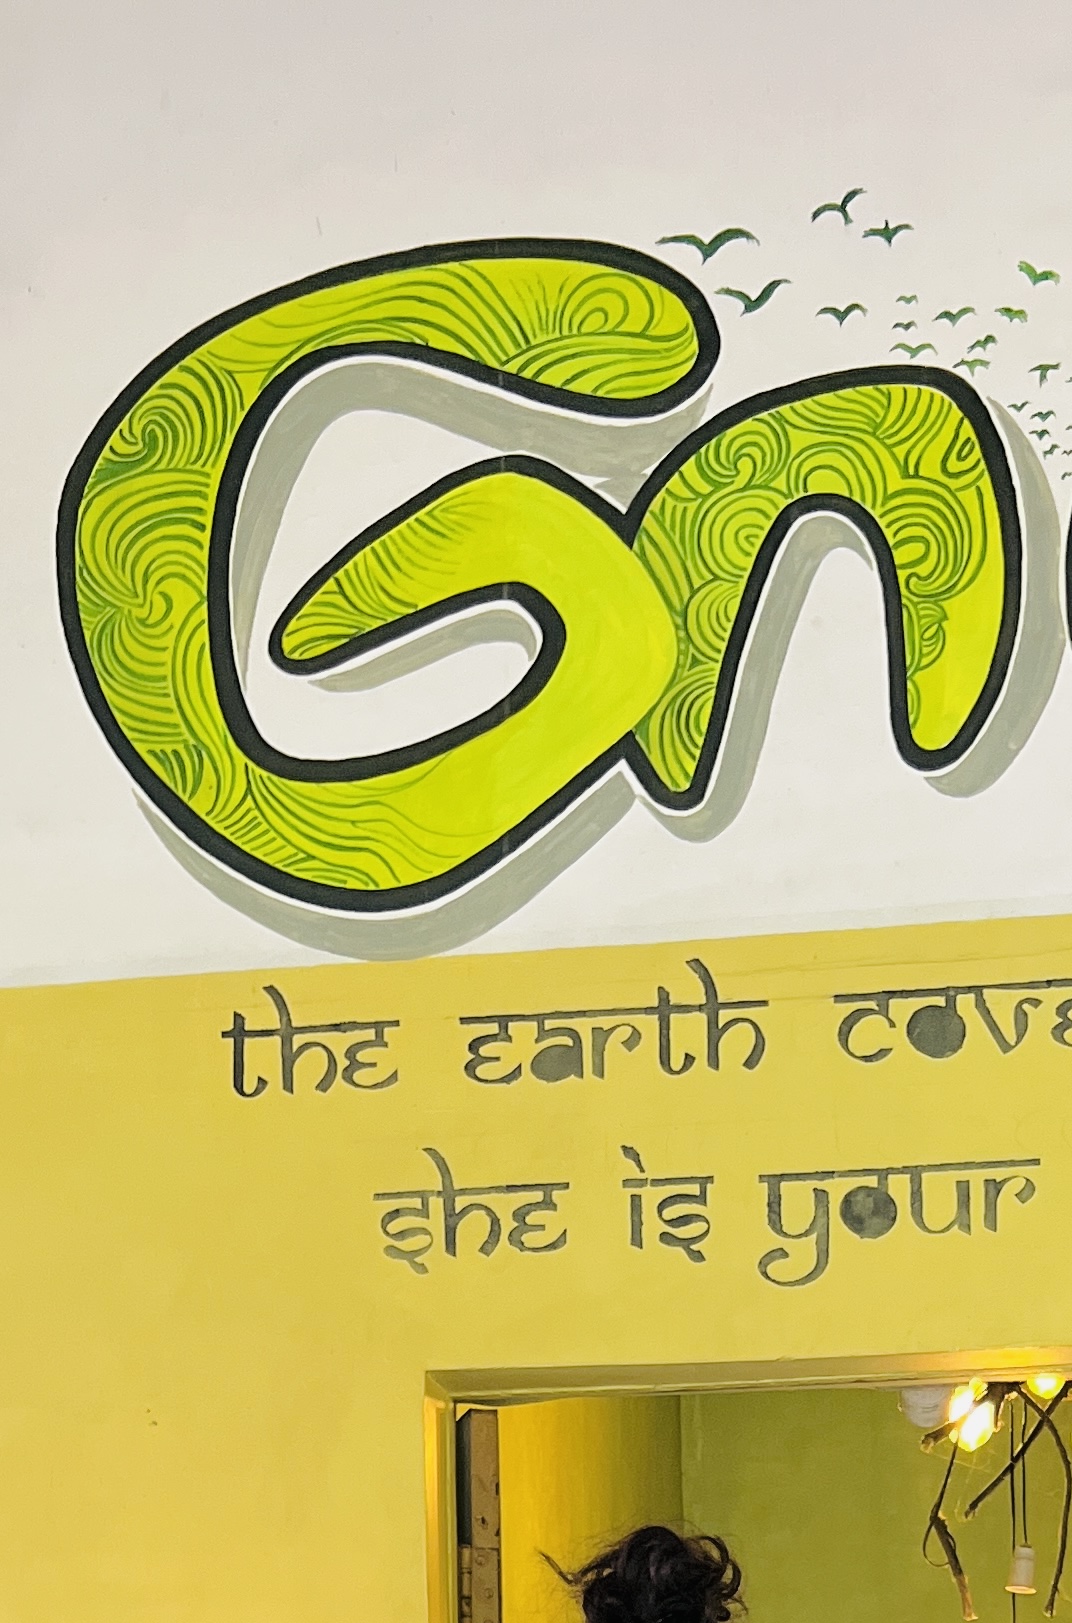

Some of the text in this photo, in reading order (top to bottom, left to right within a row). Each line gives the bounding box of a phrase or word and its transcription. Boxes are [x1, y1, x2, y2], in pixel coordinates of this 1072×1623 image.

[221, 985, 400, 1097] the
[459, 959, 768, 1084] earth
[374, 1148, 569, 1274] she
[621, 1145, 714, 1263] is
[758, 1159, 1040, 1287] your
